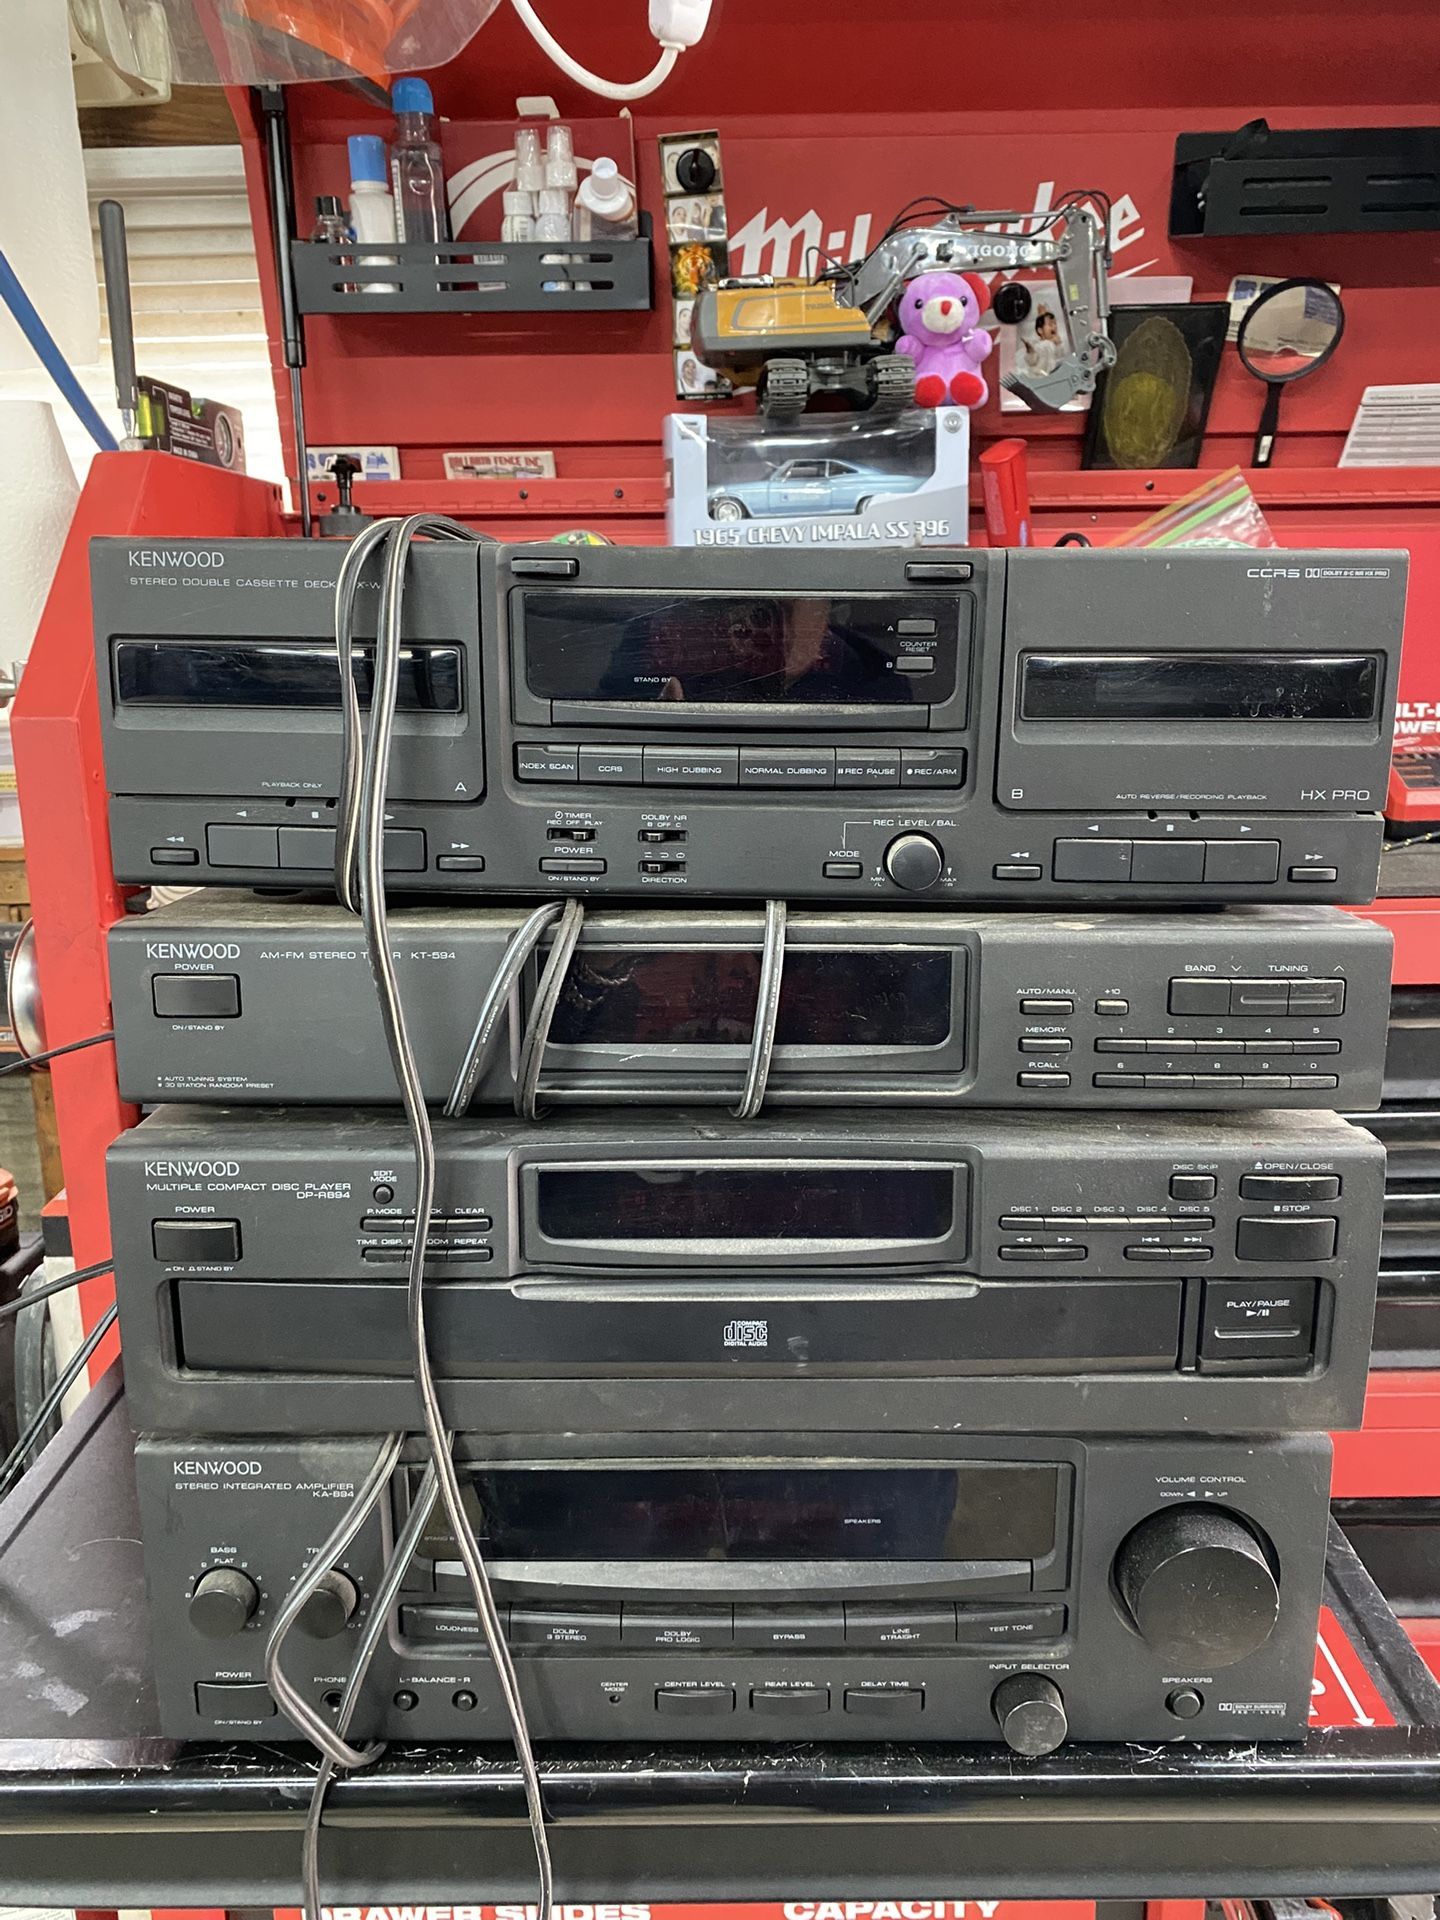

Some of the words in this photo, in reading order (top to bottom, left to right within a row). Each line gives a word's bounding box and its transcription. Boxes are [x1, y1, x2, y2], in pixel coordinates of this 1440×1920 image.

[694, 528, 741, 546] 1965
[747, 526, 808, 544] CHEVY
[811, 524, 881, 542] IMPALA
[885, 521, 910, 539] SS
[914, 519, 950, 538] 396
[129, 551, 224, 567] KENWOOD
[1247, 569, 1300, 578] CCRS
[183, 578, 229, 586] DOUBLE
[236, 579, 298, 587] CASSETTE
[304, 580, 336, 588] DECK
[455, 782, 466, 791] A
[1012, 789, 1023, 798] B
[1301, 790, 1326, 800] HX
[1333, 790, 1369, 800] PRO
[642, 875, 687, 883] DIRECTION
[147, 944, 240, 958] KENWOOD
[145, 1162, 239, 1176] KENWOOD
[1227, 1300, 1289, 1308] PLAY/PAUSE
[724, 1321, 767, 1341] disc
[174, 1461, 261, 1475] KENWOOD
[782, 1901, 999, 1920] CAPACITY
